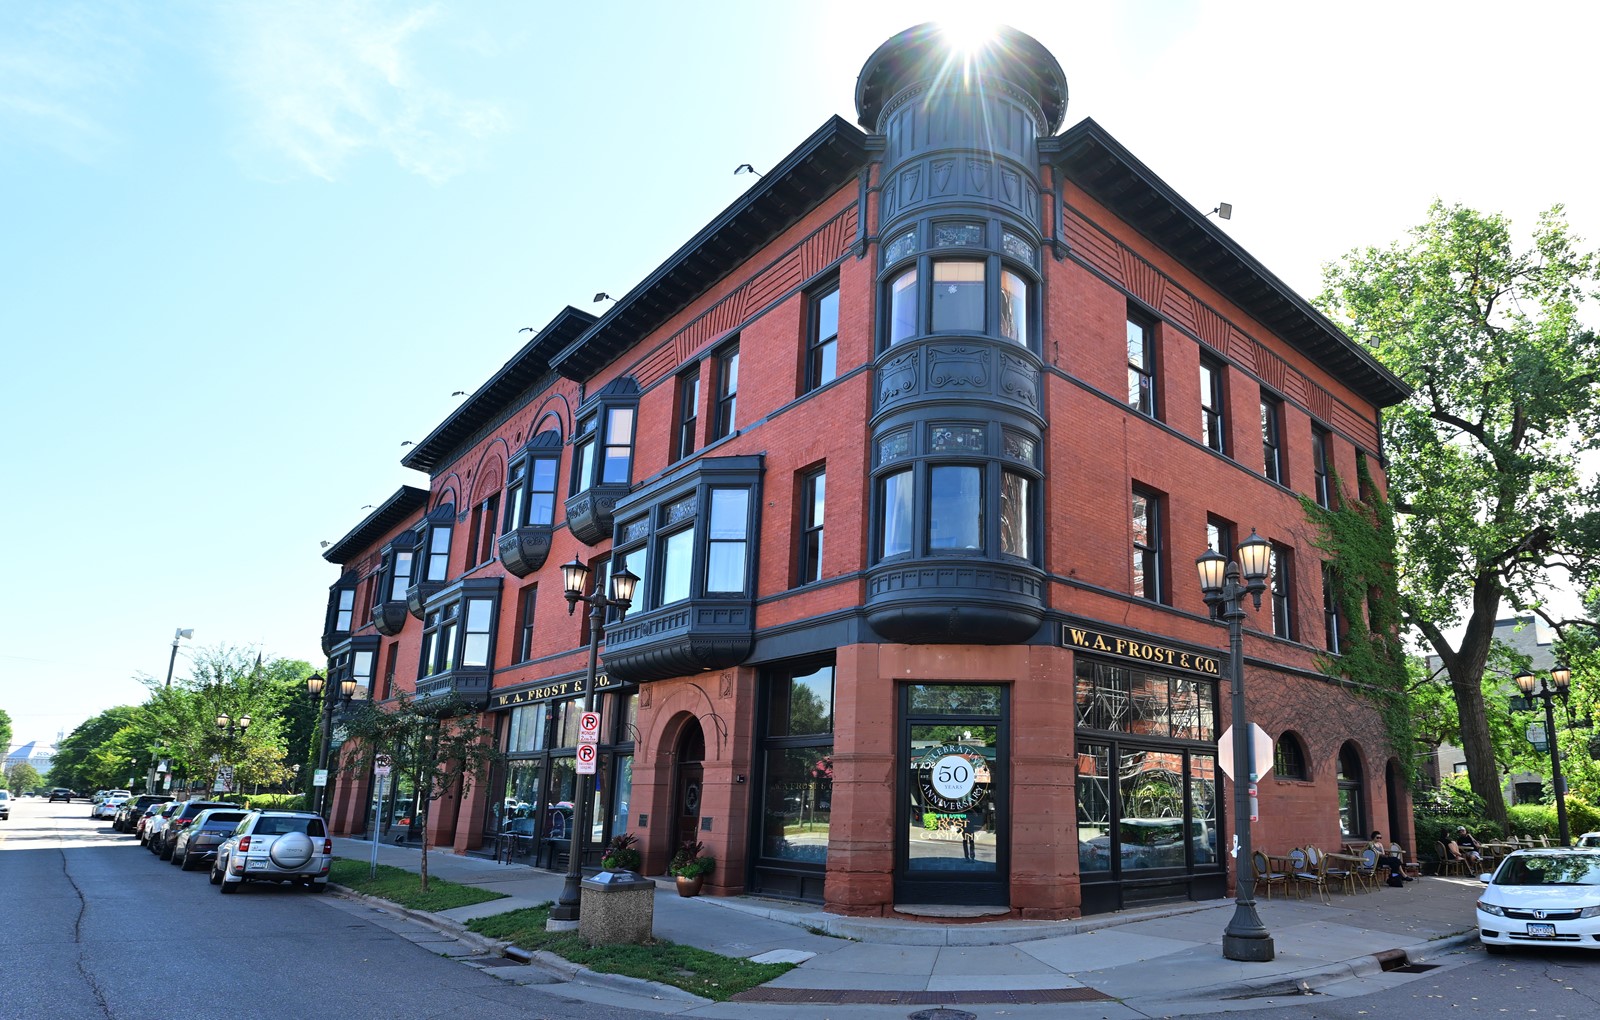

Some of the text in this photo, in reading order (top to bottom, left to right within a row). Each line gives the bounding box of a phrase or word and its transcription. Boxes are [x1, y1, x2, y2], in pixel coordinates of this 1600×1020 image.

[1069, 628, 1218, 674] W. A. FROST & CO.
[499, 696, 509, 706] W.
[512, 693, 523, 703] A.
[527, 683, 568, 701] FROST
[574, 680, 583, 692] &
[938, 765, 968, 783] 50
[922, 783, 984, 811] ANNIVERSARY
[920, 832, 982, 841] COMPANY
